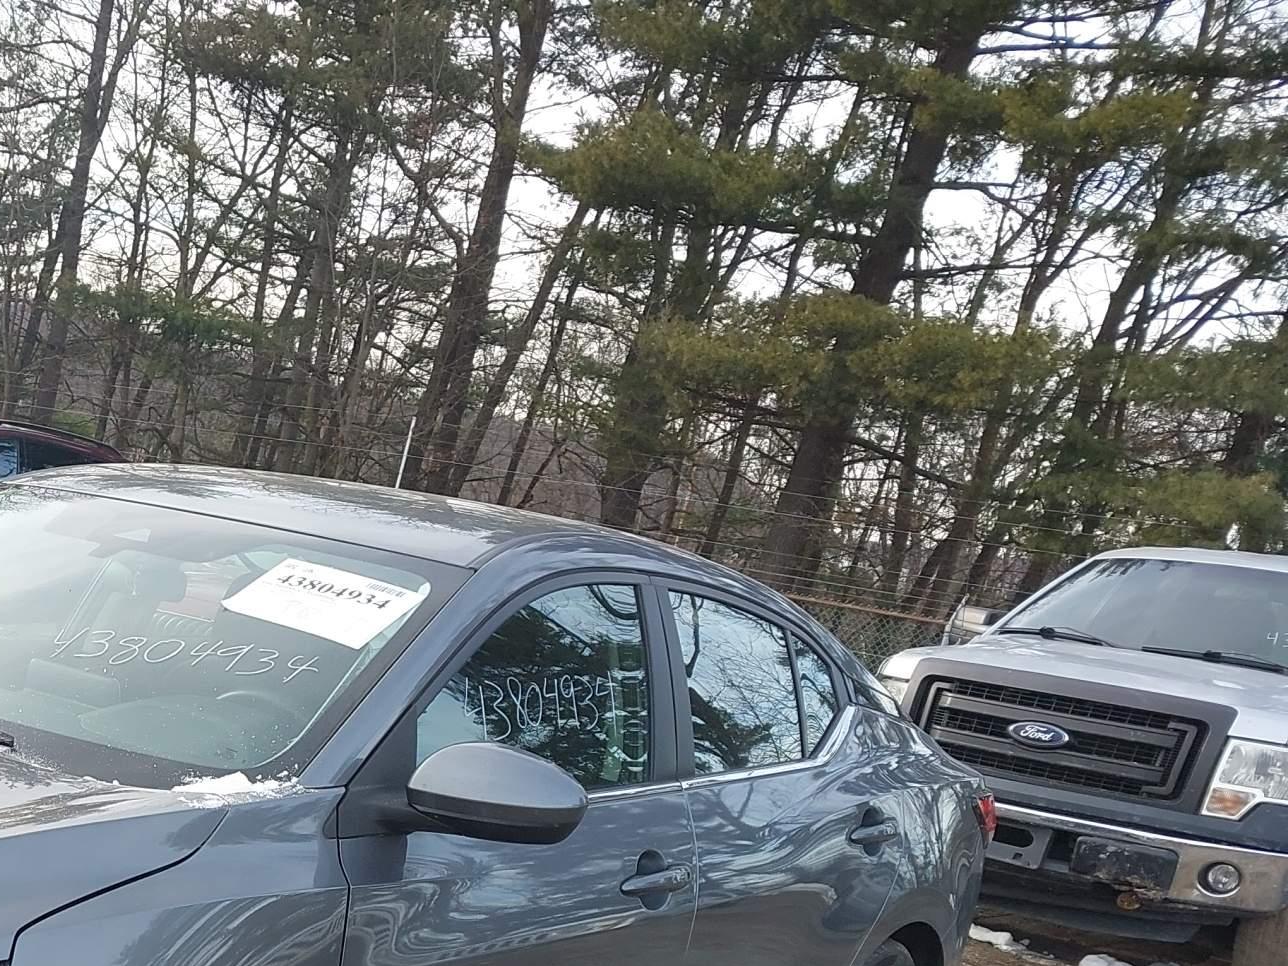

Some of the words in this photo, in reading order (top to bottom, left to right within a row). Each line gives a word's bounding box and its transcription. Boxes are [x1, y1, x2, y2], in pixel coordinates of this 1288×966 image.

[277, 574, 392, 610] 43804934
[49, 627, 320, 683] 43804934
[464, 671, 617, 741] 43804934
[1020, 724, 1055, 741] Ford
